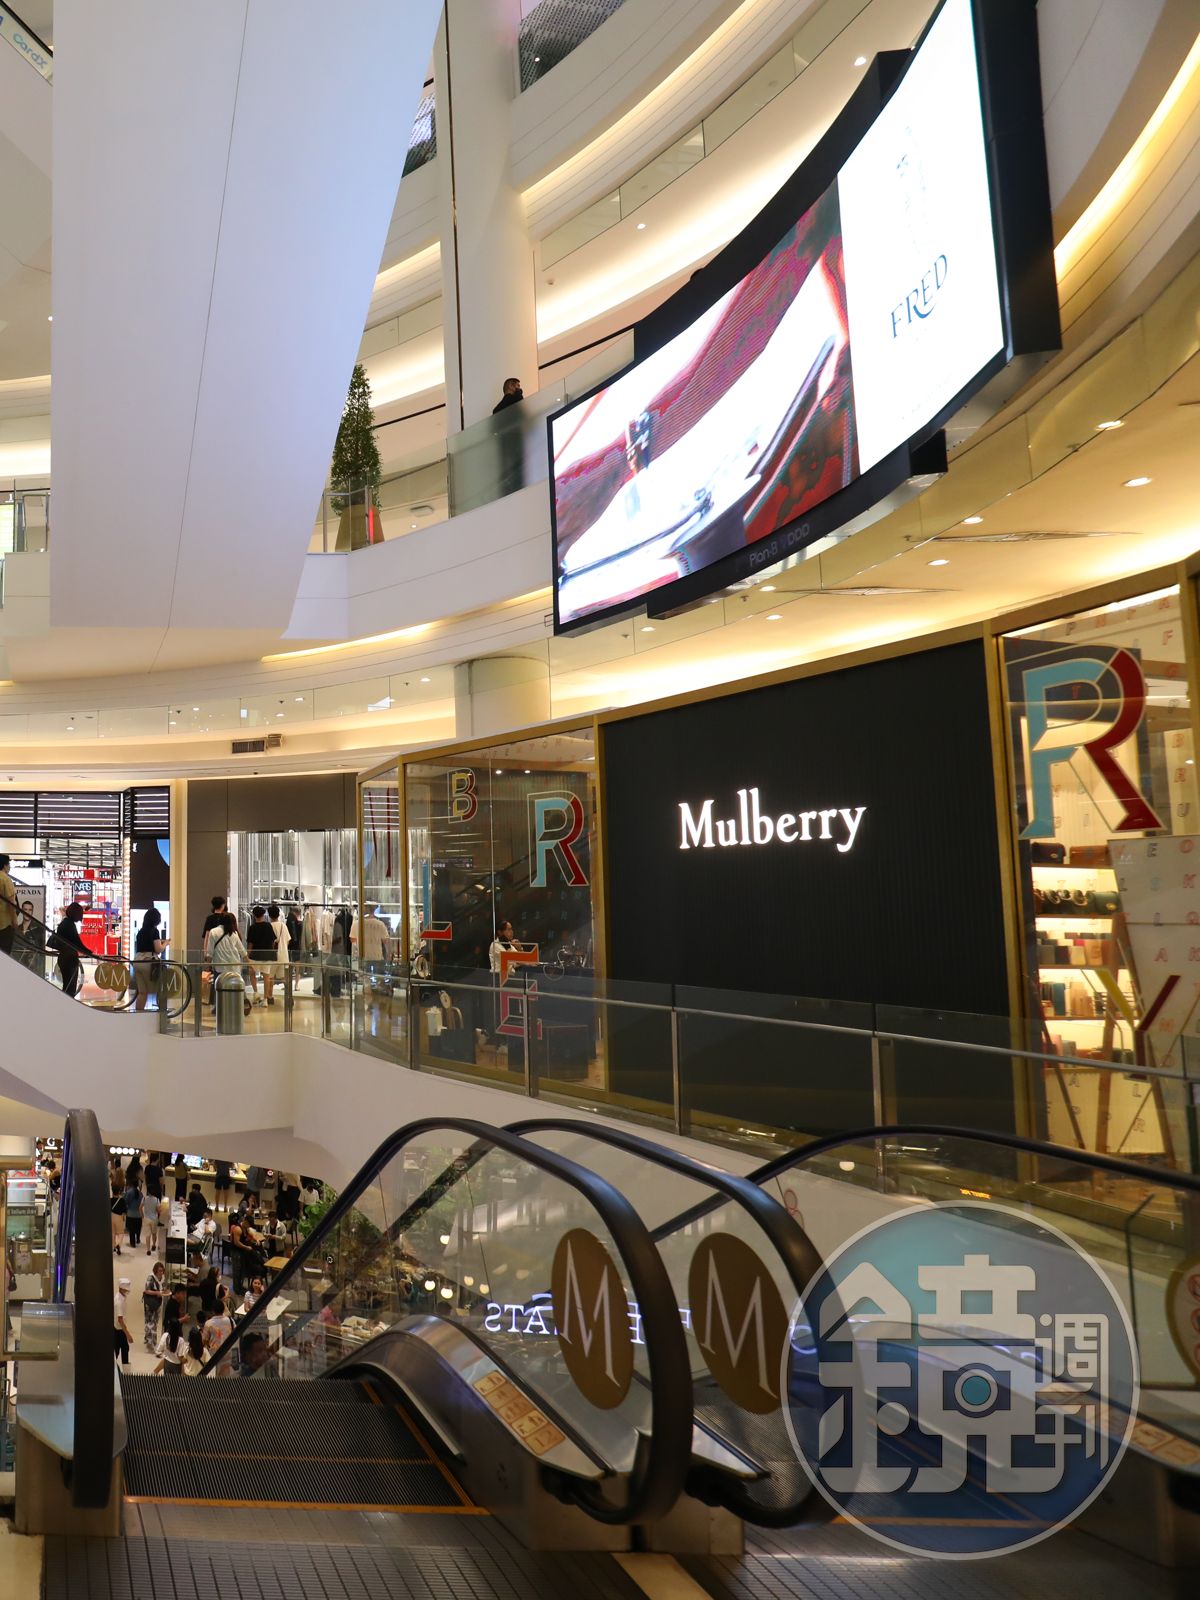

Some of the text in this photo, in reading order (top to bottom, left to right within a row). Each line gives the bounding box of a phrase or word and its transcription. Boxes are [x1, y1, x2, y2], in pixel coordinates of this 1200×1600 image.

[13, 33, 48, 69] CardX
[890, 253, 949, 338] FRED
[1007, 643, 1166, 840] R
[447, 767, 478, 824] B
[678, 788, 867, 853] Mulberry
[527, 790, 589, 888] R
[74, 882, 92, 892] NARS
[560, 1238, 621, 1389] M
[701, 1249, 779, 1400] M
